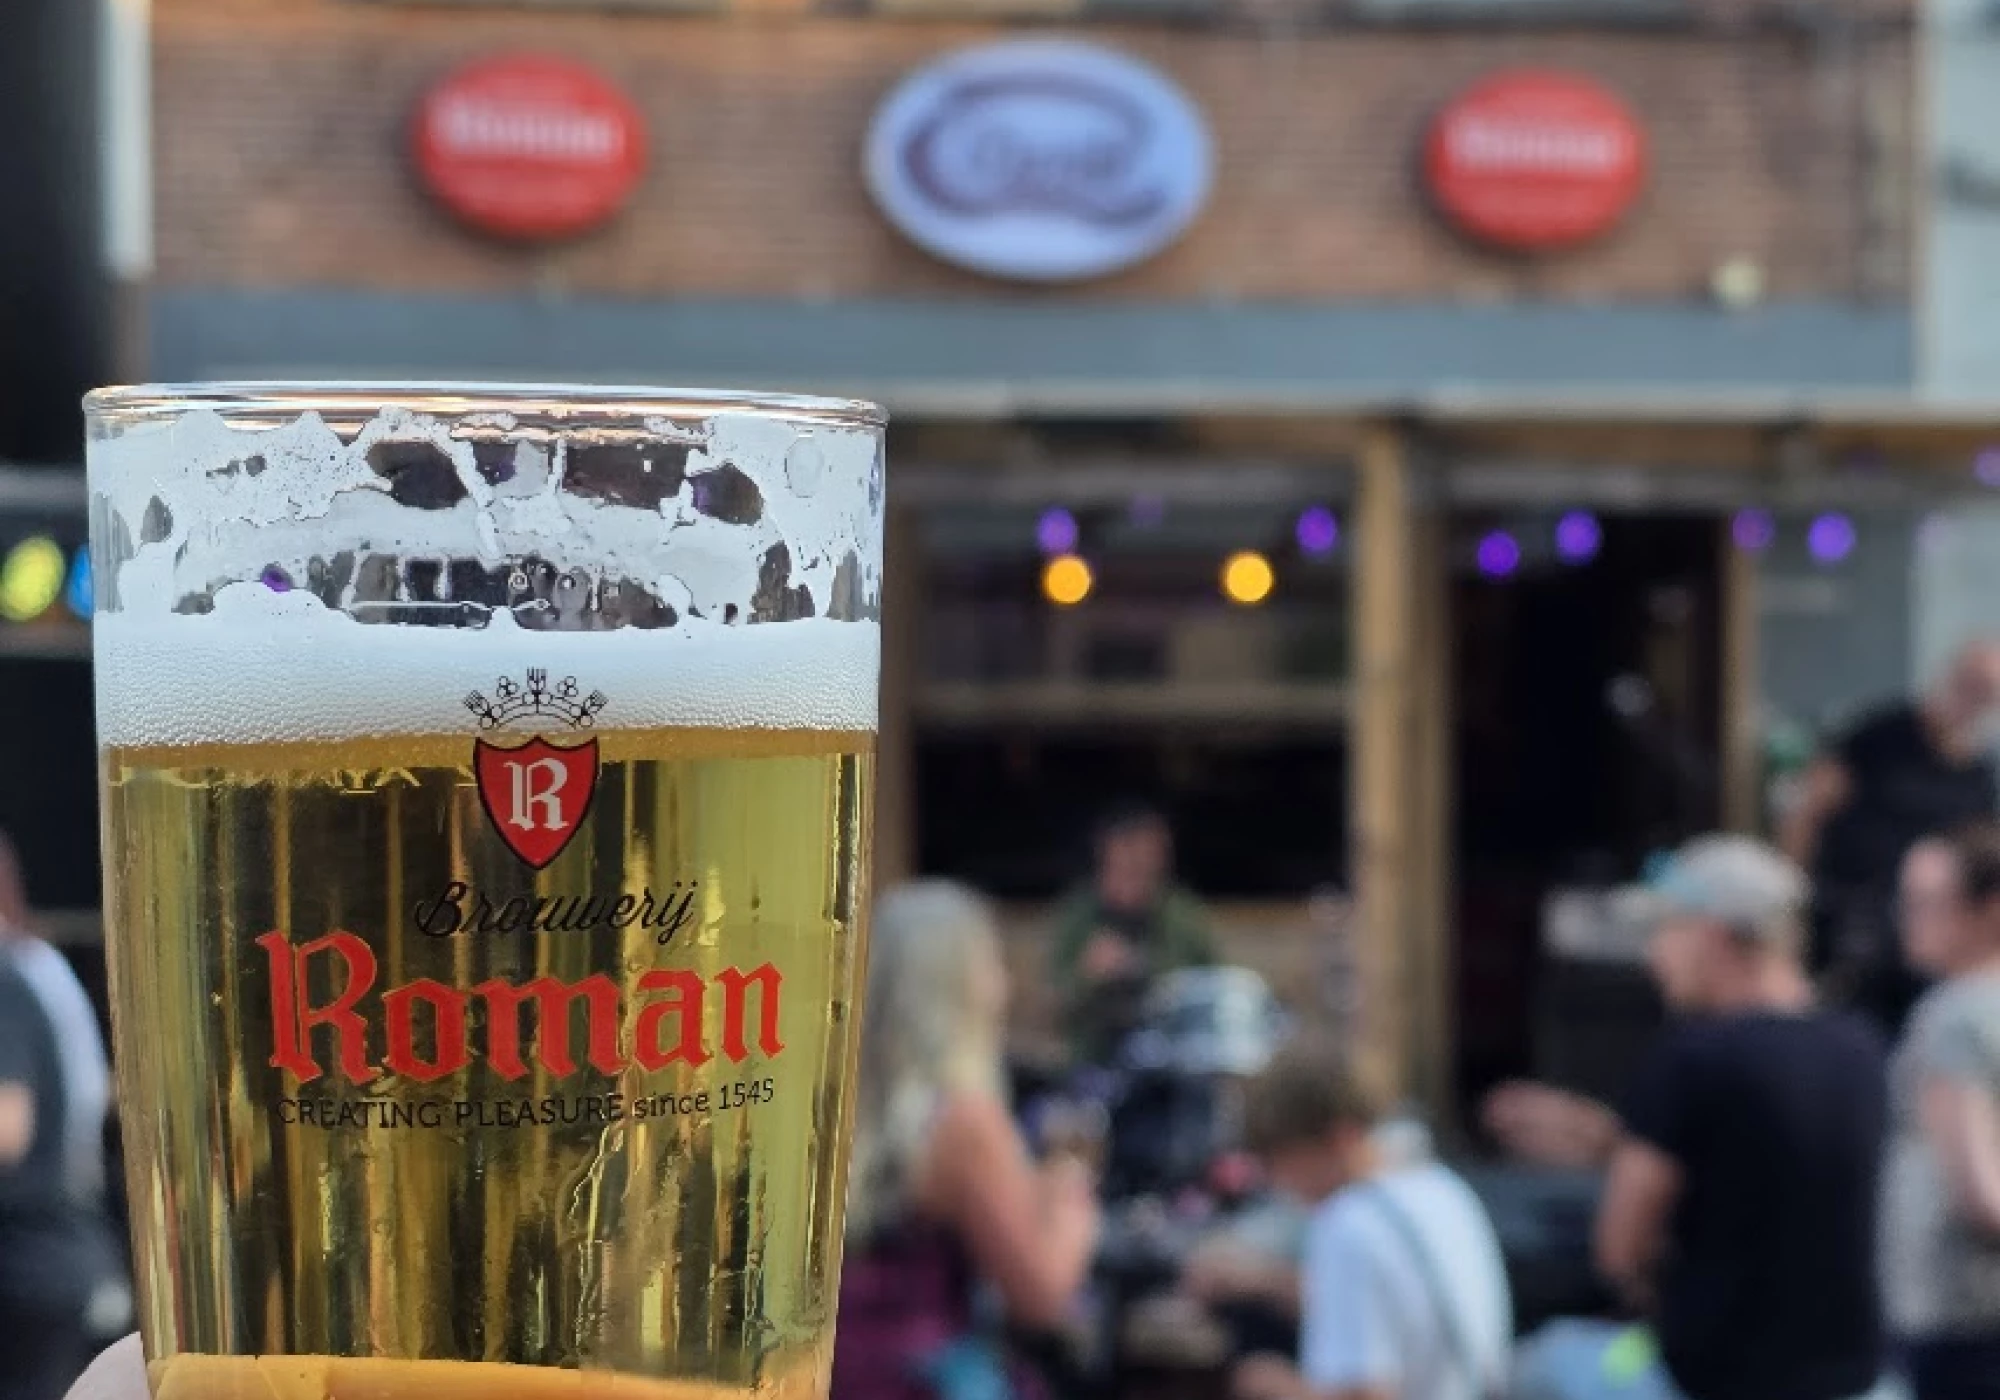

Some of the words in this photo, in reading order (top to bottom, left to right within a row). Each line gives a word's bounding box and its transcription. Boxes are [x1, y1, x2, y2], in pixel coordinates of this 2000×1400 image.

[503, 757, 568, 831] R
[414, 880, 698, 944] Brouwerij
[255, 929, 784, 1087] Roman
[277, 1099, 441, 1129] CREATING
[453, 1094, 624, 1126] PLEASURE
[633, 1092, 709, 1119] since
[718, 1079, 774, 1110] 1545
